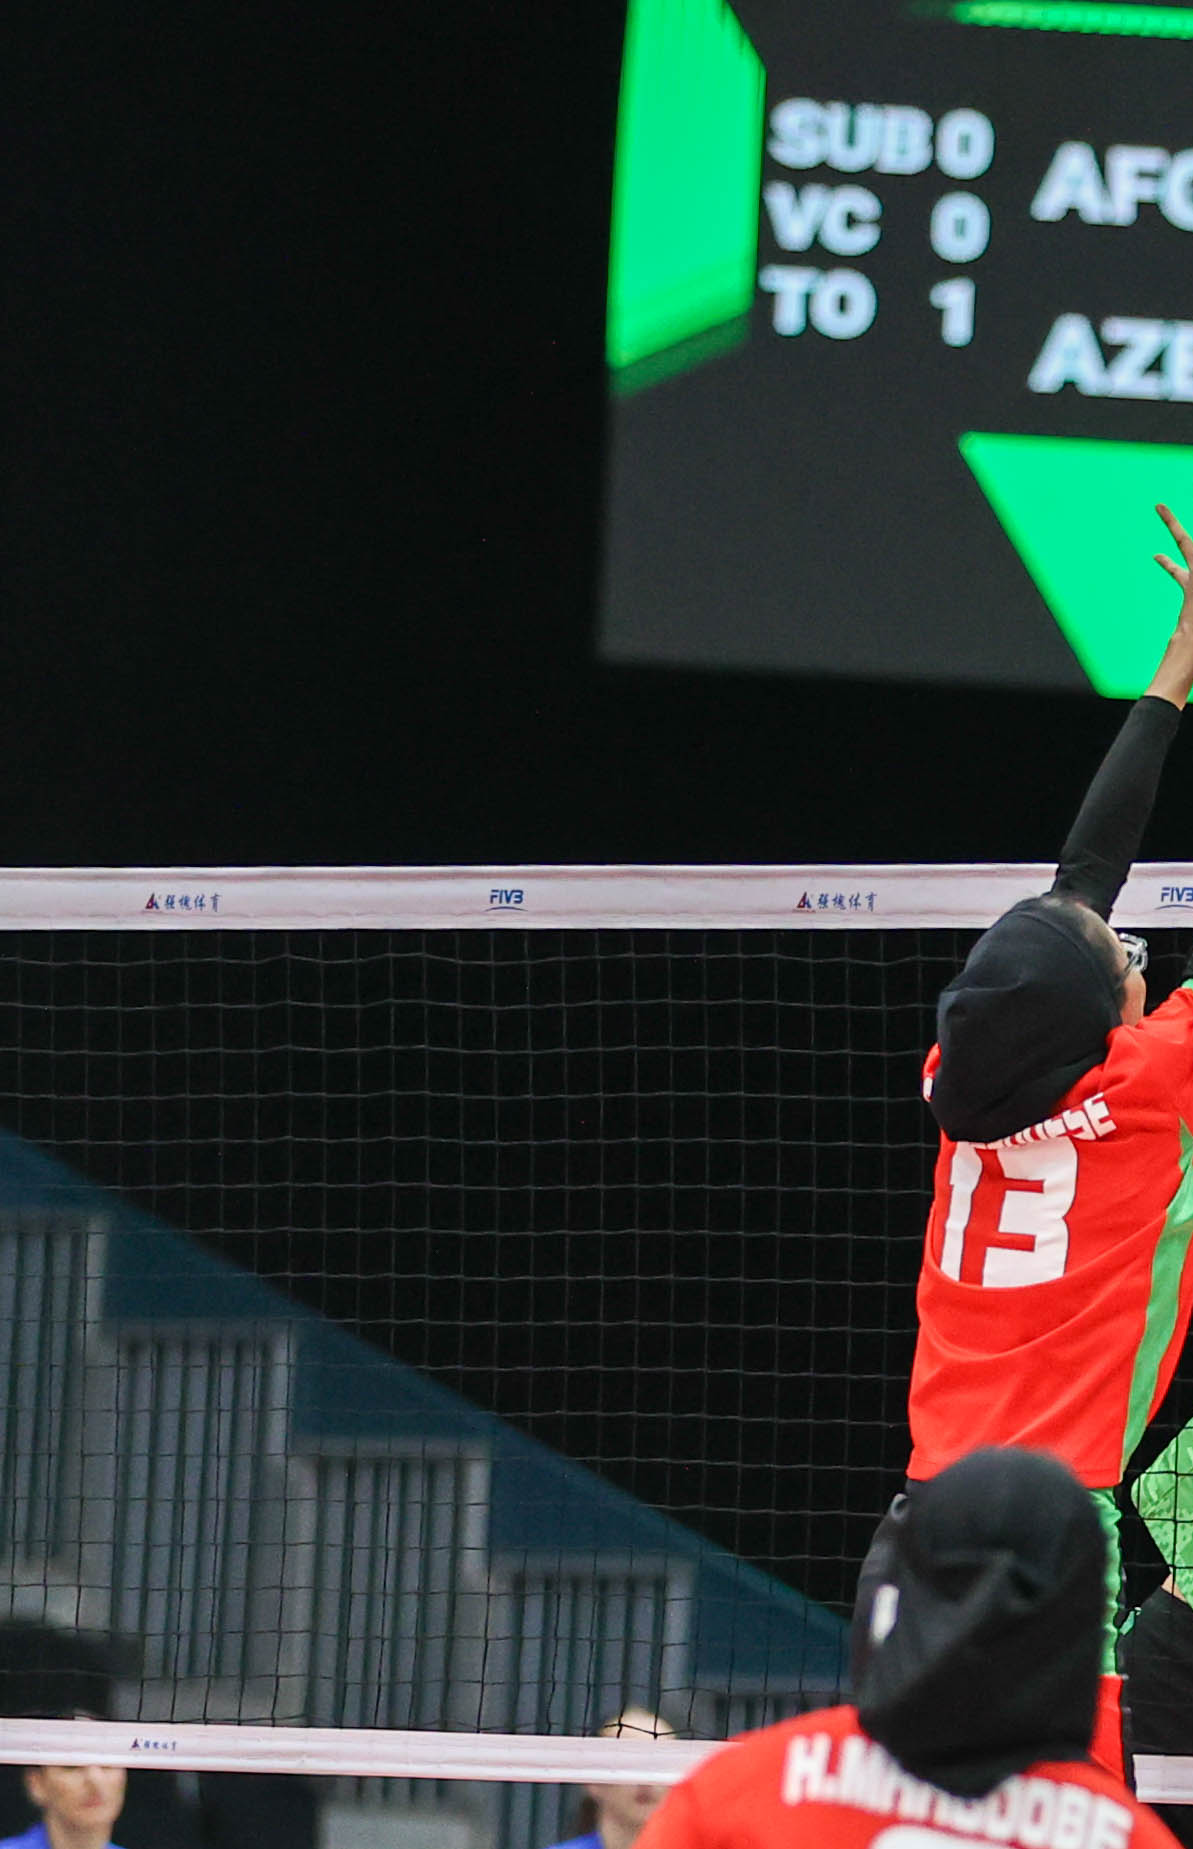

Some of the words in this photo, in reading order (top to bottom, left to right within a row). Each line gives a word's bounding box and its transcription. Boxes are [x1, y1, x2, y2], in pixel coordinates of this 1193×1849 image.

[769, 97, 932, 175] SUB
[936, 108, 993, 179] 0
[764, 181, 880, 255] VC
[930, 193, 989, 262] 0
[761, 266, 876, 339] TO
[930, 278, 975, 346] 1
[940, 1140, 1078, 1288] 13
